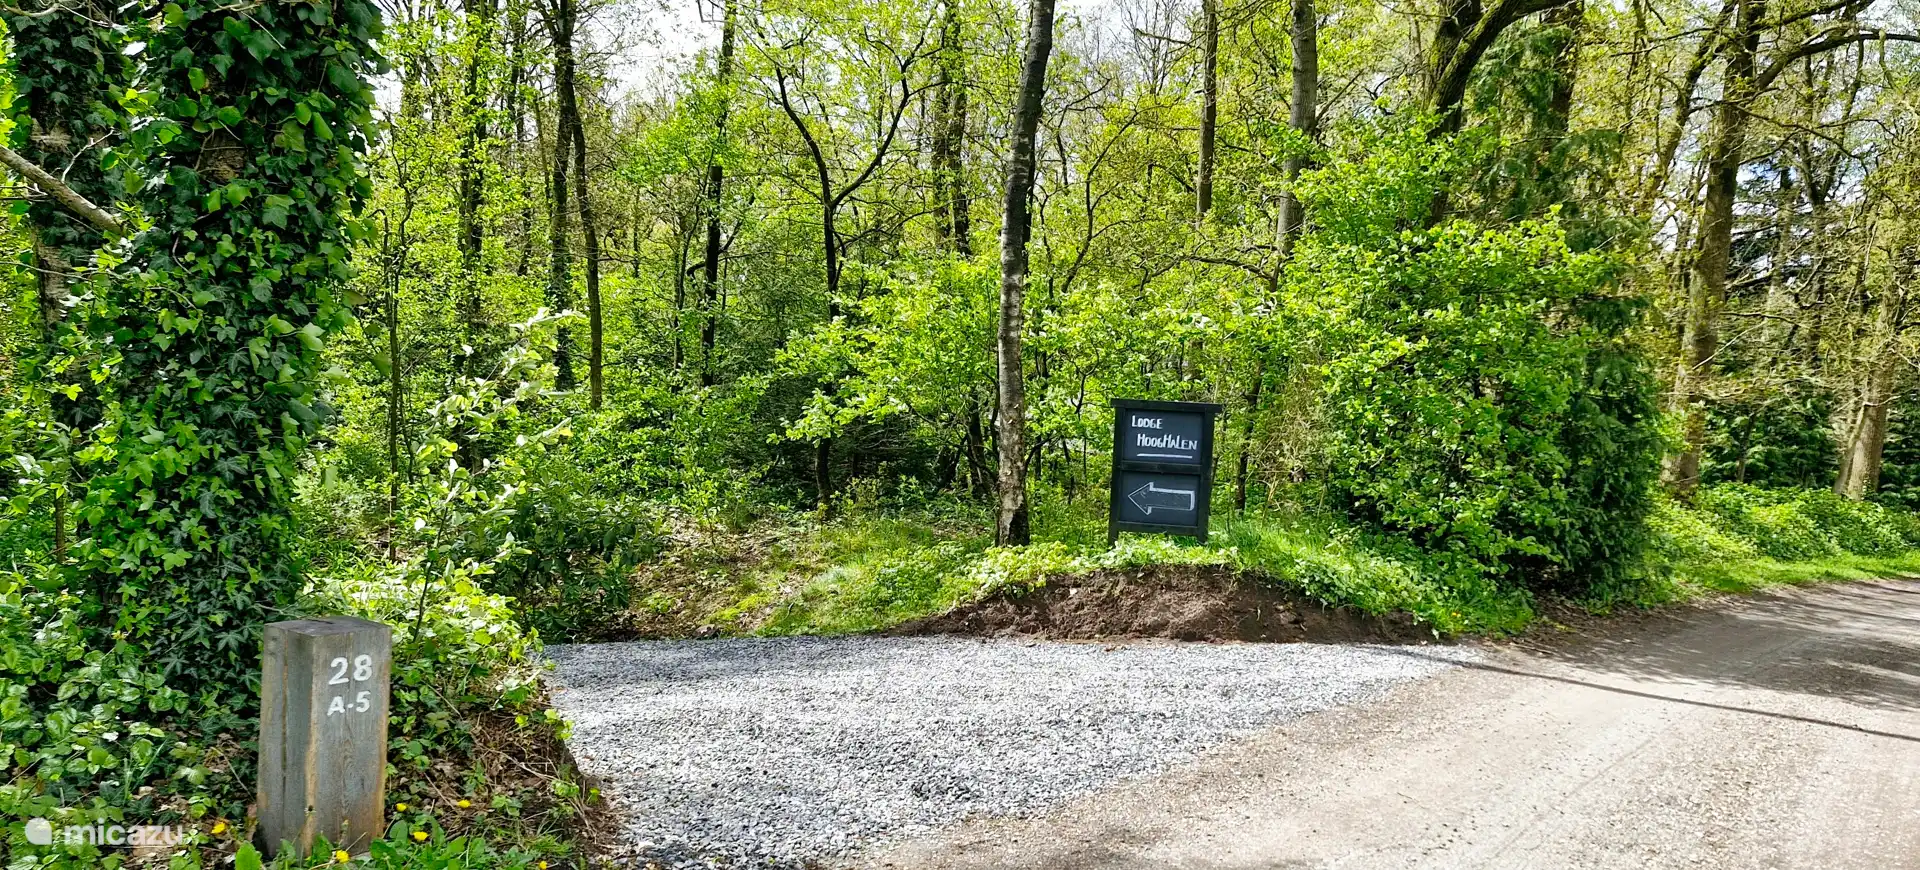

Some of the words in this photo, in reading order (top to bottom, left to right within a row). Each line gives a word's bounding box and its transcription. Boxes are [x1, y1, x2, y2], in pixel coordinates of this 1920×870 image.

[1132, 415, 1162, 429] LODGE
[328, 654, 373, 685] 28
[327, 690, 371, 716] A-5
